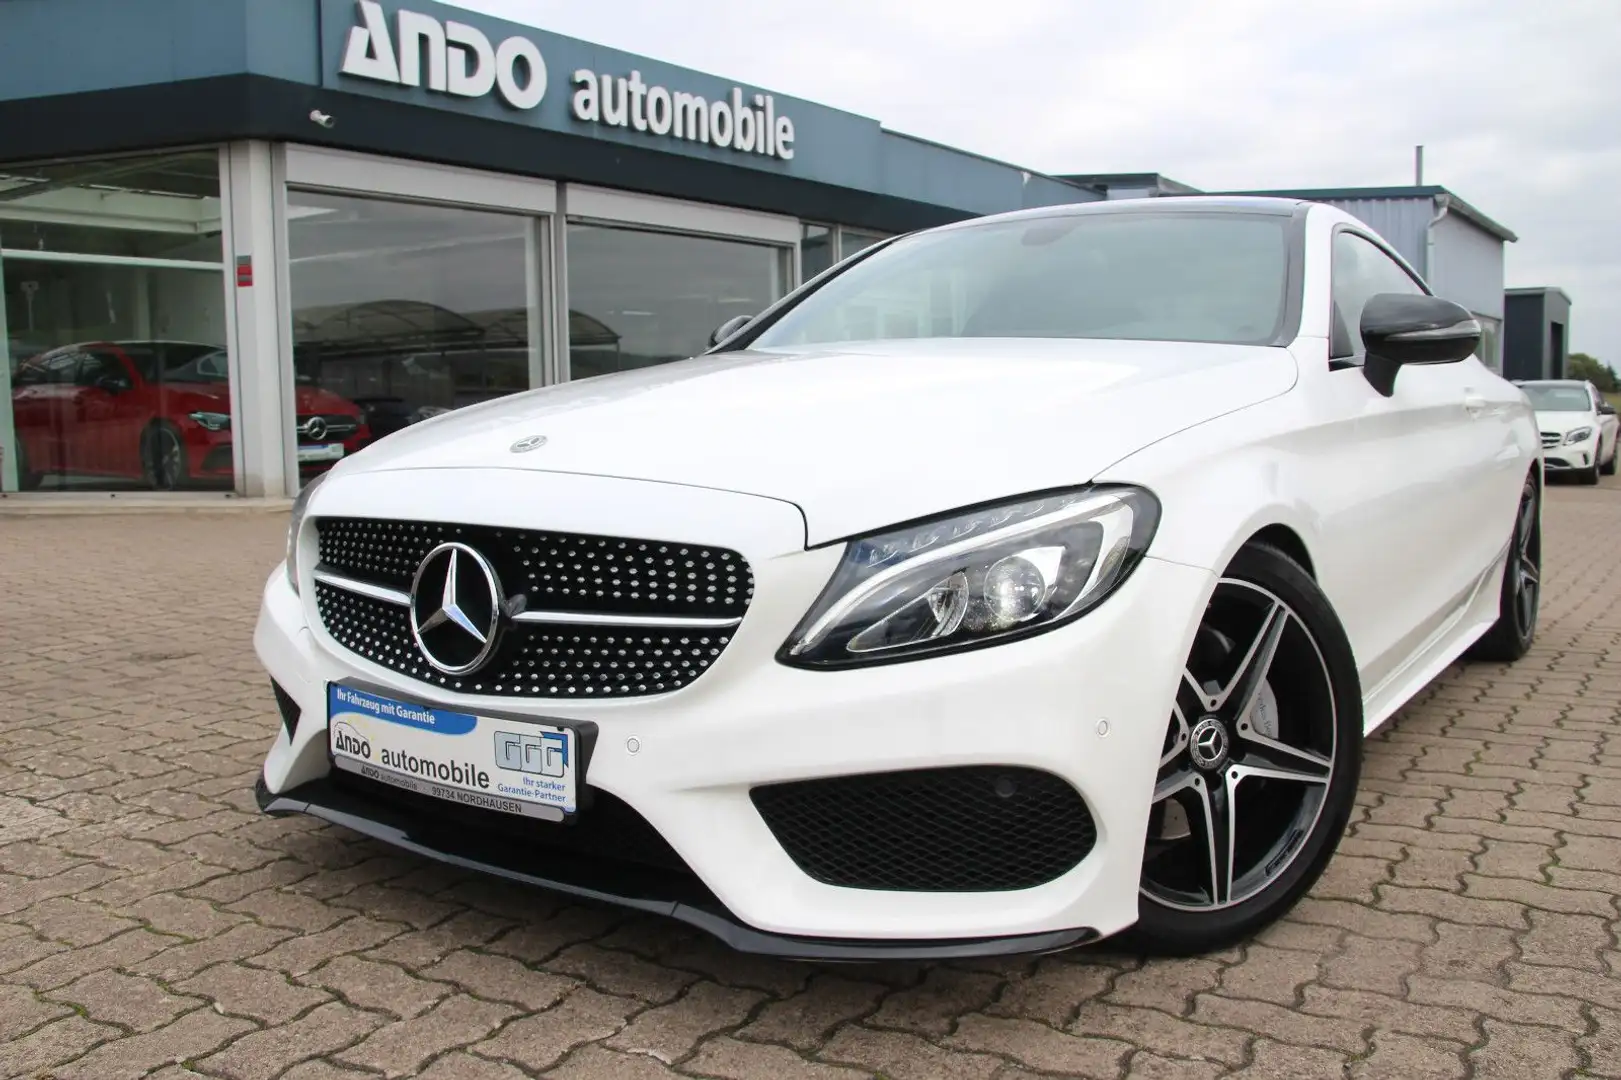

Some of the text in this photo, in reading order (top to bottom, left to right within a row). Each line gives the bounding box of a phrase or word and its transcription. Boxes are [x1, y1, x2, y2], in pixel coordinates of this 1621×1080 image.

[339, 0, 795, 160] ANDO automobile
[337, 688, 436, 725] Ihr Fahrzeug mit Garantie
[336, 731, 490, 788] ANDO automobile
[361, 764, 380, 779] ANDO
[498, 783, 566, 802] Garantie-Partner
[523, 777, 566, 791] Ihr starker
[432, 786, 522, 813] 99734 NORDHAUSEN
